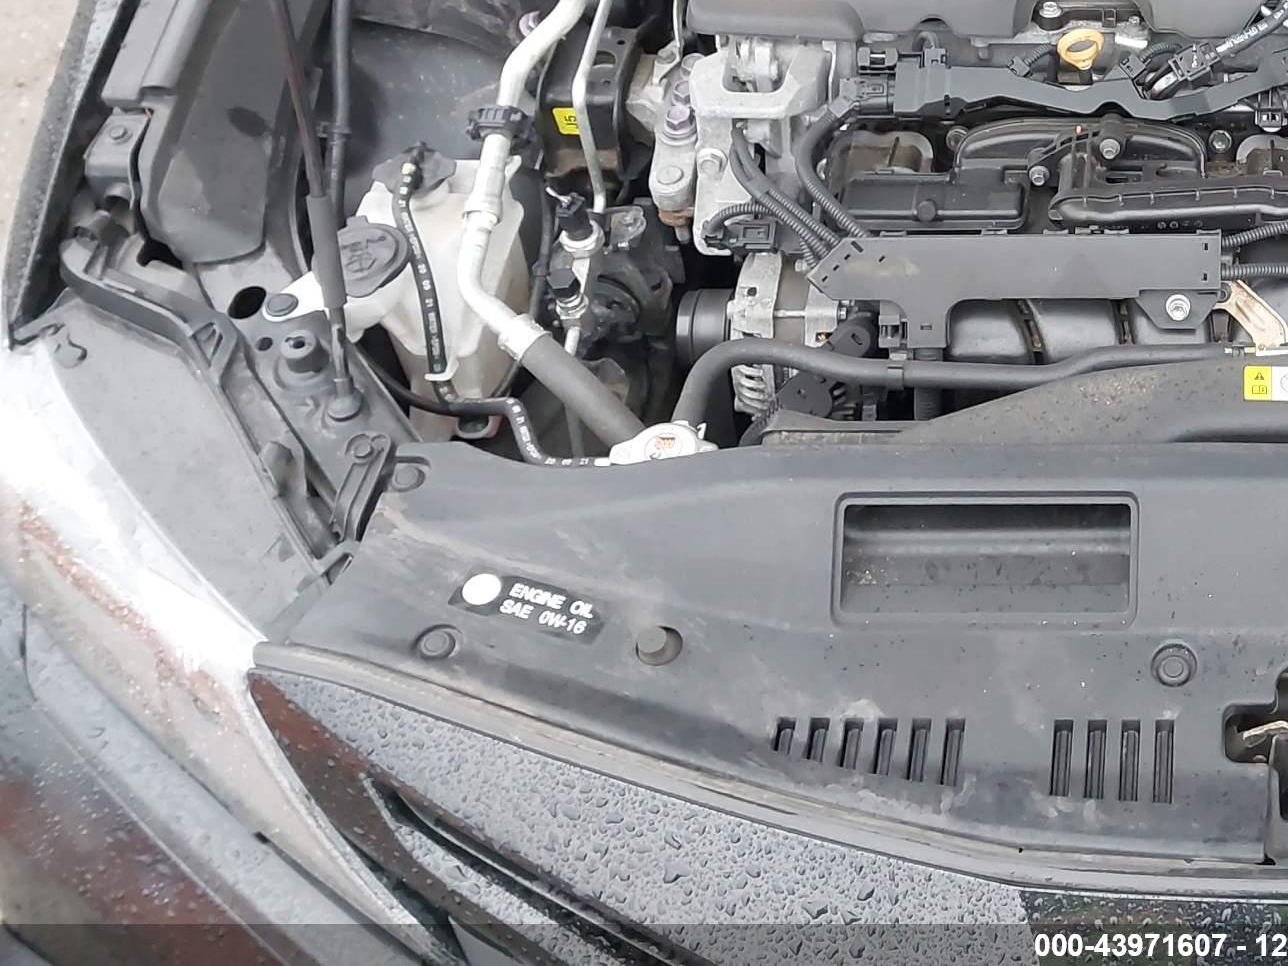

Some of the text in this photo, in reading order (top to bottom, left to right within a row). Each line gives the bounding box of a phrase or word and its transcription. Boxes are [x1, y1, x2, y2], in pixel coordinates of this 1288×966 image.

[500, 599, 587, 635] SAE 0W-16
[509, 582, 593, 619] ENGINE OIL
